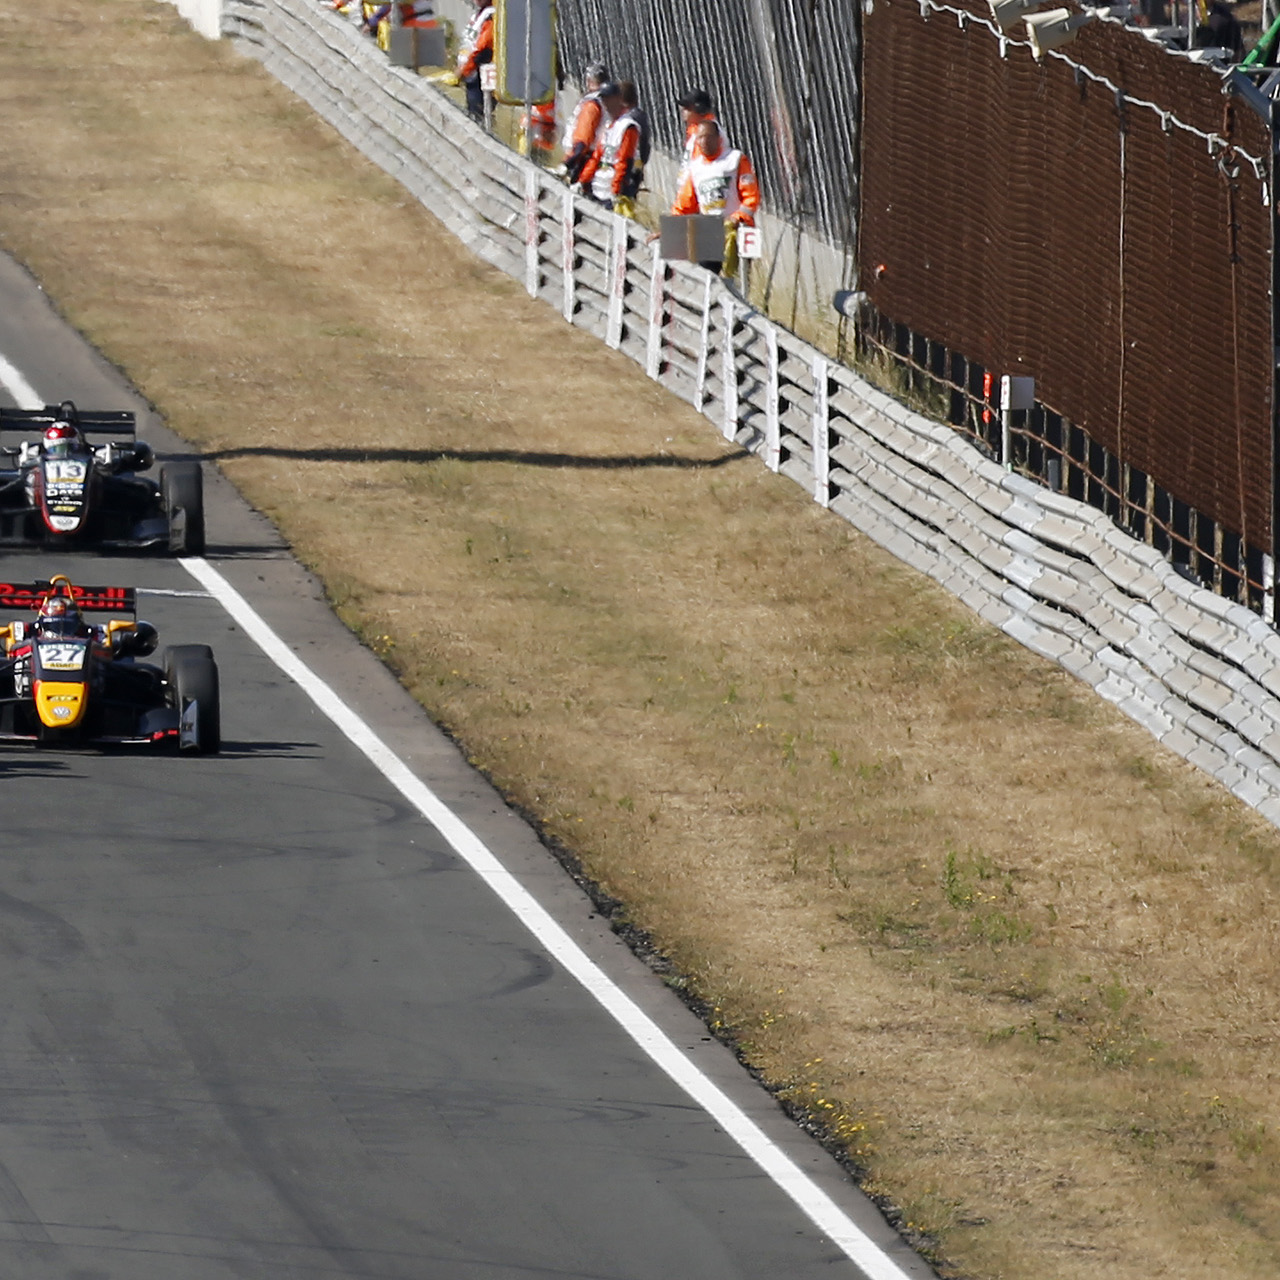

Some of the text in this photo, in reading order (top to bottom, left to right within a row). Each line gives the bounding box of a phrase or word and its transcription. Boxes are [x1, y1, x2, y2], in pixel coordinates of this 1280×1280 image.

[744, 231, 756, 253] F
[54, 465, 81, 477] 13
[62, 586, 126, 608] Bull
[45, 648, 83, 662] 27
